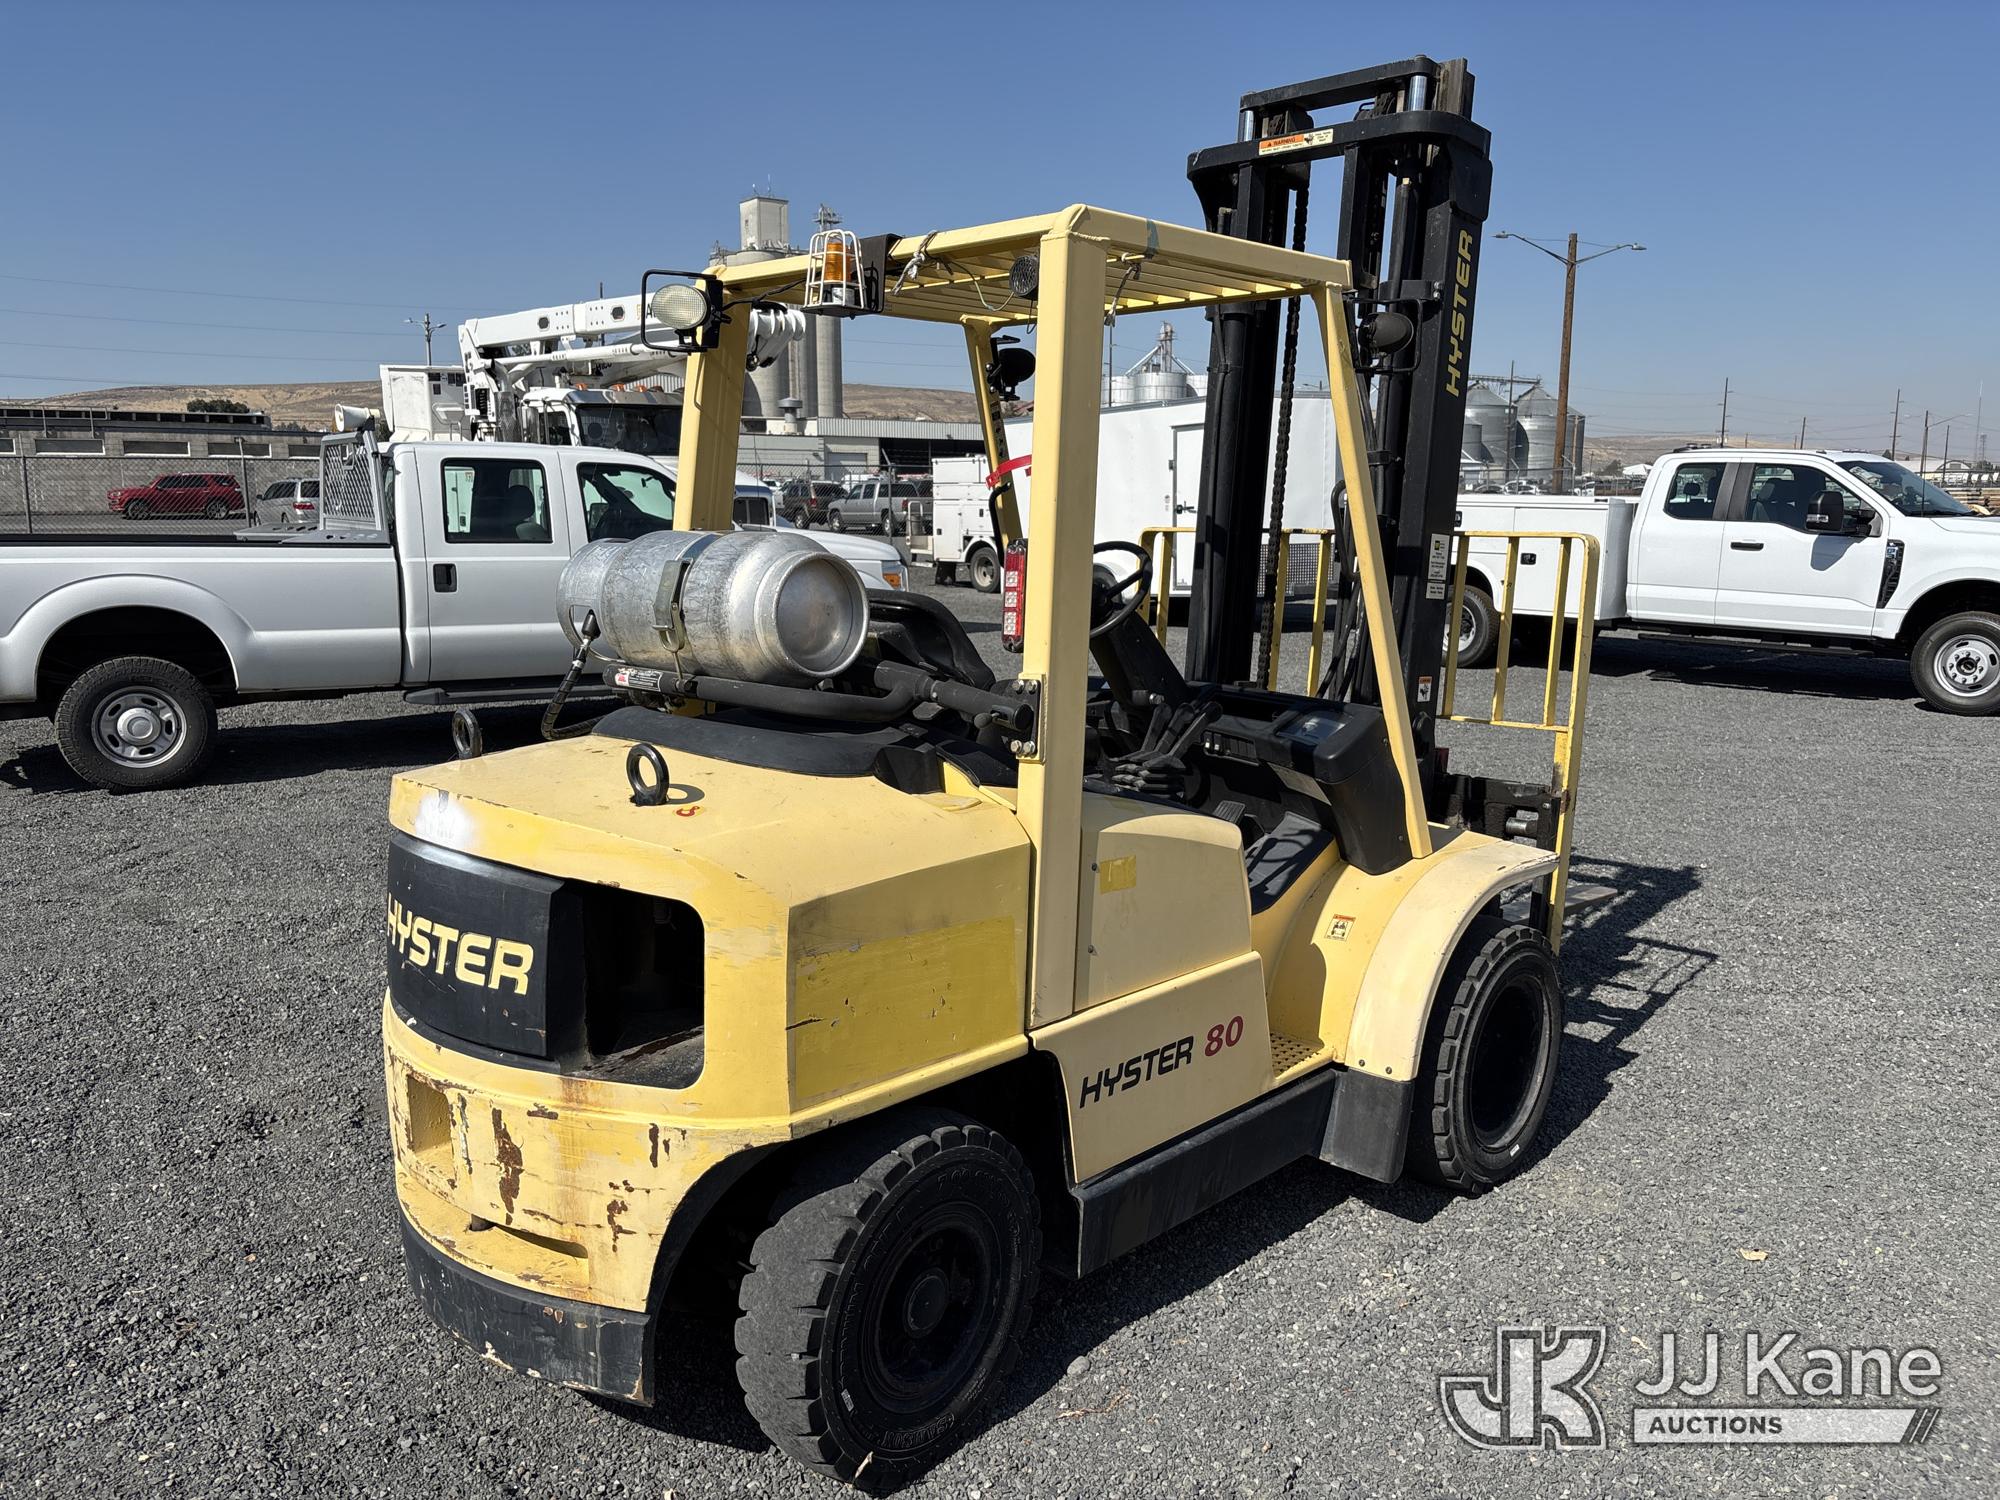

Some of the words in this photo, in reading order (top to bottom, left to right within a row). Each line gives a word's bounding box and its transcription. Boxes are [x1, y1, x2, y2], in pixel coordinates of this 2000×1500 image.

[1445, 229, 1473, 398] HYSTER
[386, 891, 535, 996] HYSTER
[1079, 1035, 1195, 1109] HYSTER
[1204, 1015, 1244, 1057] 80
